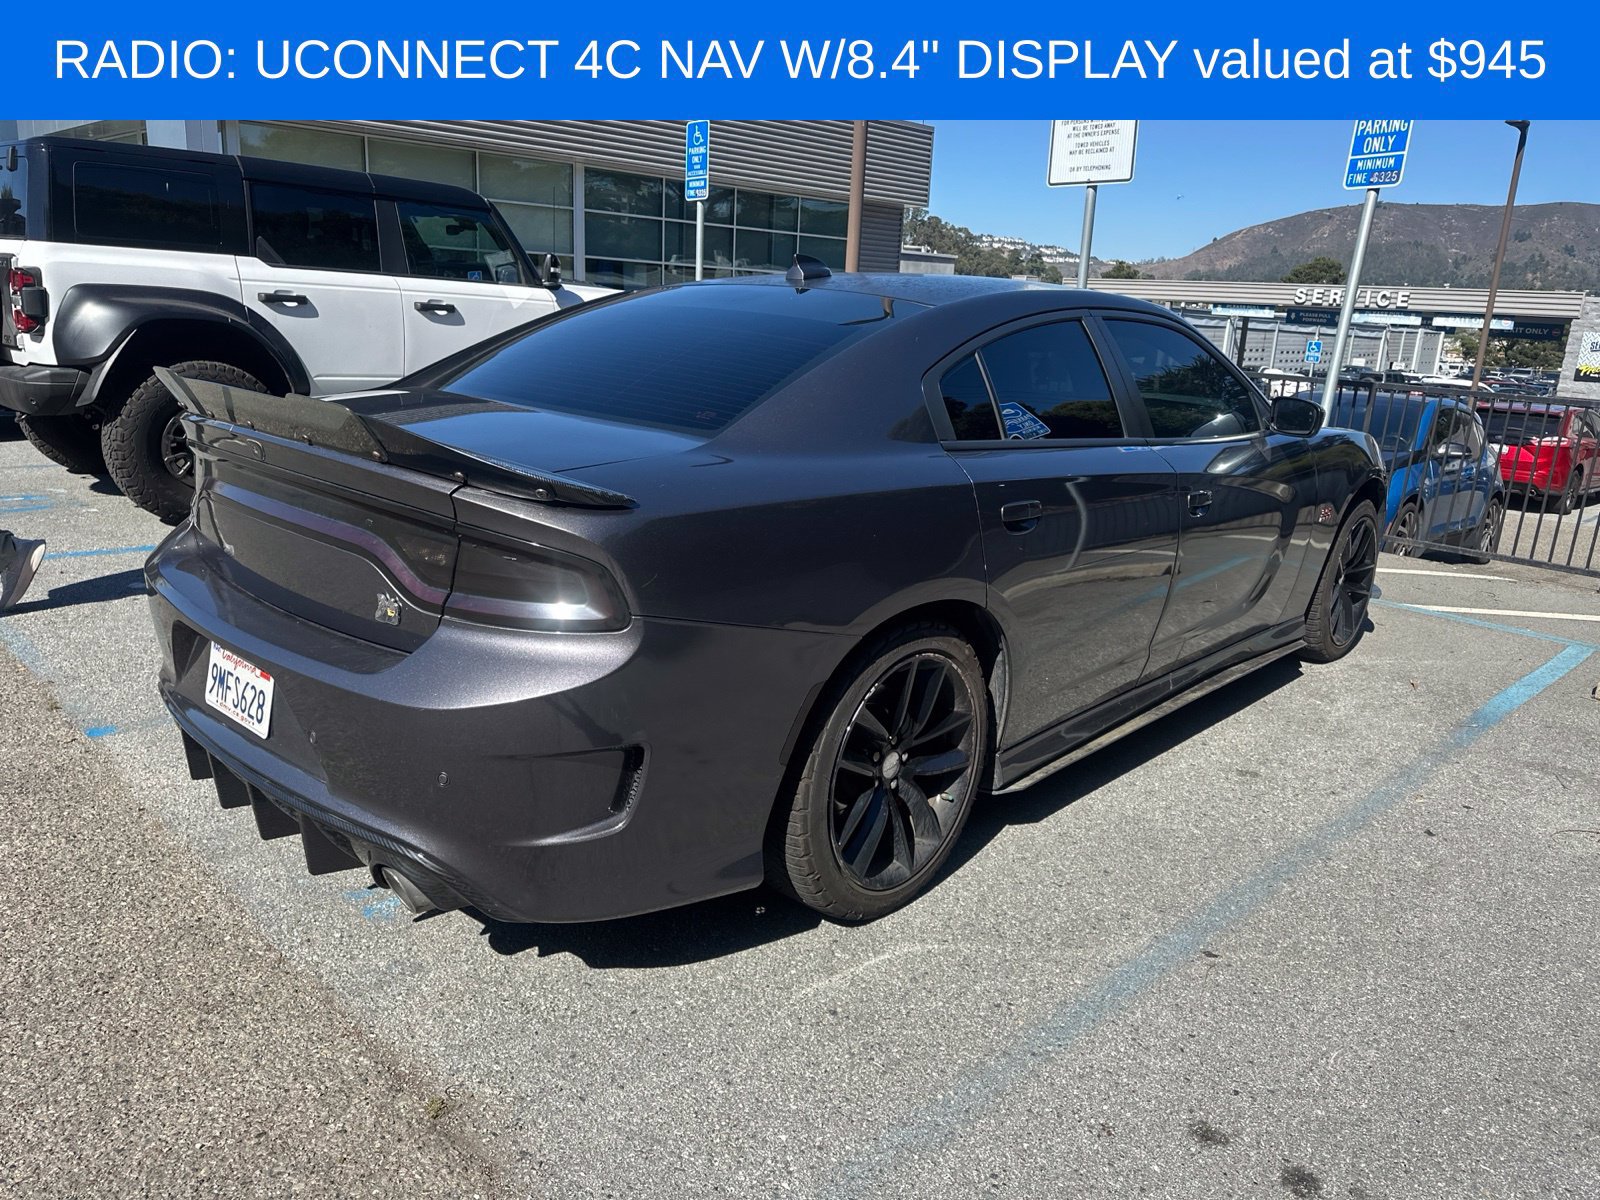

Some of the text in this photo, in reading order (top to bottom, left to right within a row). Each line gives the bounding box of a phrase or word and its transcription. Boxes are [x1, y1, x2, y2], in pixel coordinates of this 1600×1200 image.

[1100, 128, 1120, 136] EXPENSE
[1358, 120, 1408, 136] PARKING
[688, 146, 706, 155] PARKING
[1363, 134, 1397, 153] ONLY
[692, 156, 702, 164] ONLY
[1356, 157, 1396, 171] MINIMUM
[1347, 170, 1399, 185] FINE $325
[1295, 288, 1410, 307] SERICE
[1472, 317, 1499, 325] ONY
[209, 663, 266, 724] 9MFS628
